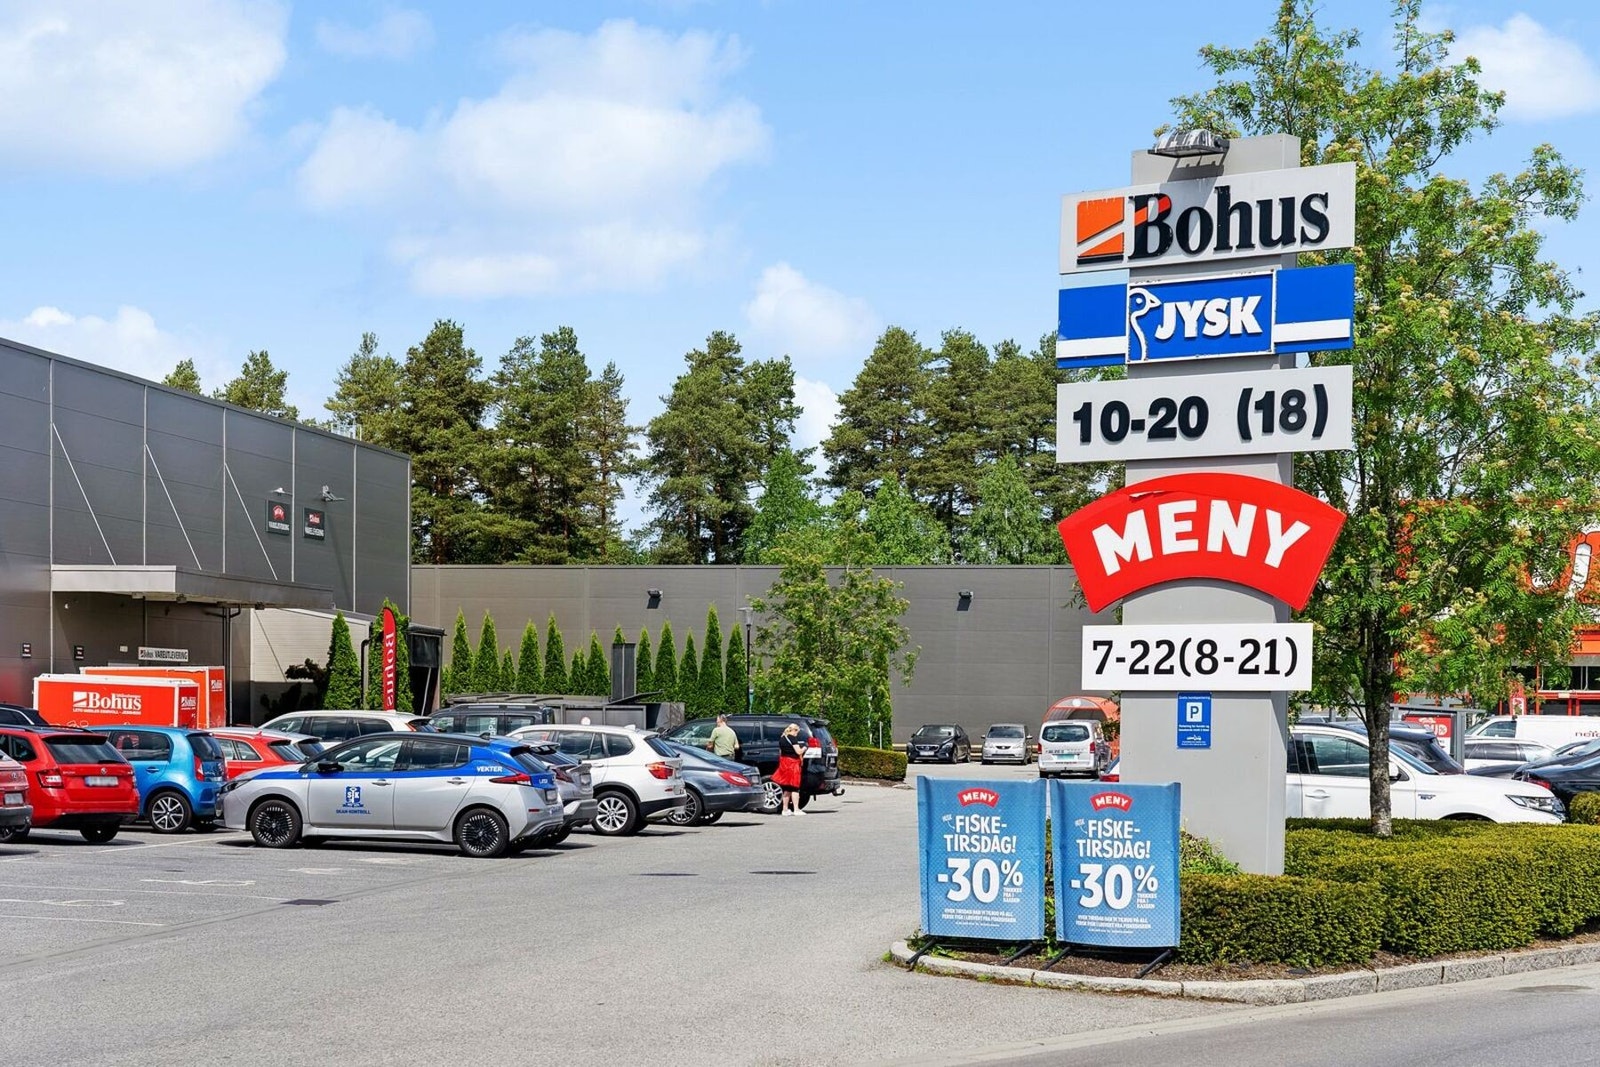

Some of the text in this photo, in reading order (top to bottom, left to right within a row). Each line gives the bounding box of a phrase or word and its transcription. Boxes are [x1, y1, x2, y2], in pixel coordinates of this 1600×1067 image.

[1128, 185, 1330, 260] Bohus
[1155, 296, 1263, 340] JYSK
[1073, 384, 1329, 444] 10-20 (18)
[1092, 499, 1311, 576] MENY
[1092, 637, 1298, 677] 7-22(8-21)
[384, 633, 395, 706] Bohus
[88, 692, 142, 711] Bohus
[1190, 705, 1200, 719] P
[476, 765, 503, 773] VEKTER
[962, 791, 996, 803] MENY
[1095, 795, 1129, 807] MENY
[955, 813, 1008, 834] FISKE-
[1087, 818, 1141, 839] FISKE-
[943, 834, 1017, 854] TIRSDAG!
[1075, 839, 1151, 859] TIRSDAG!
